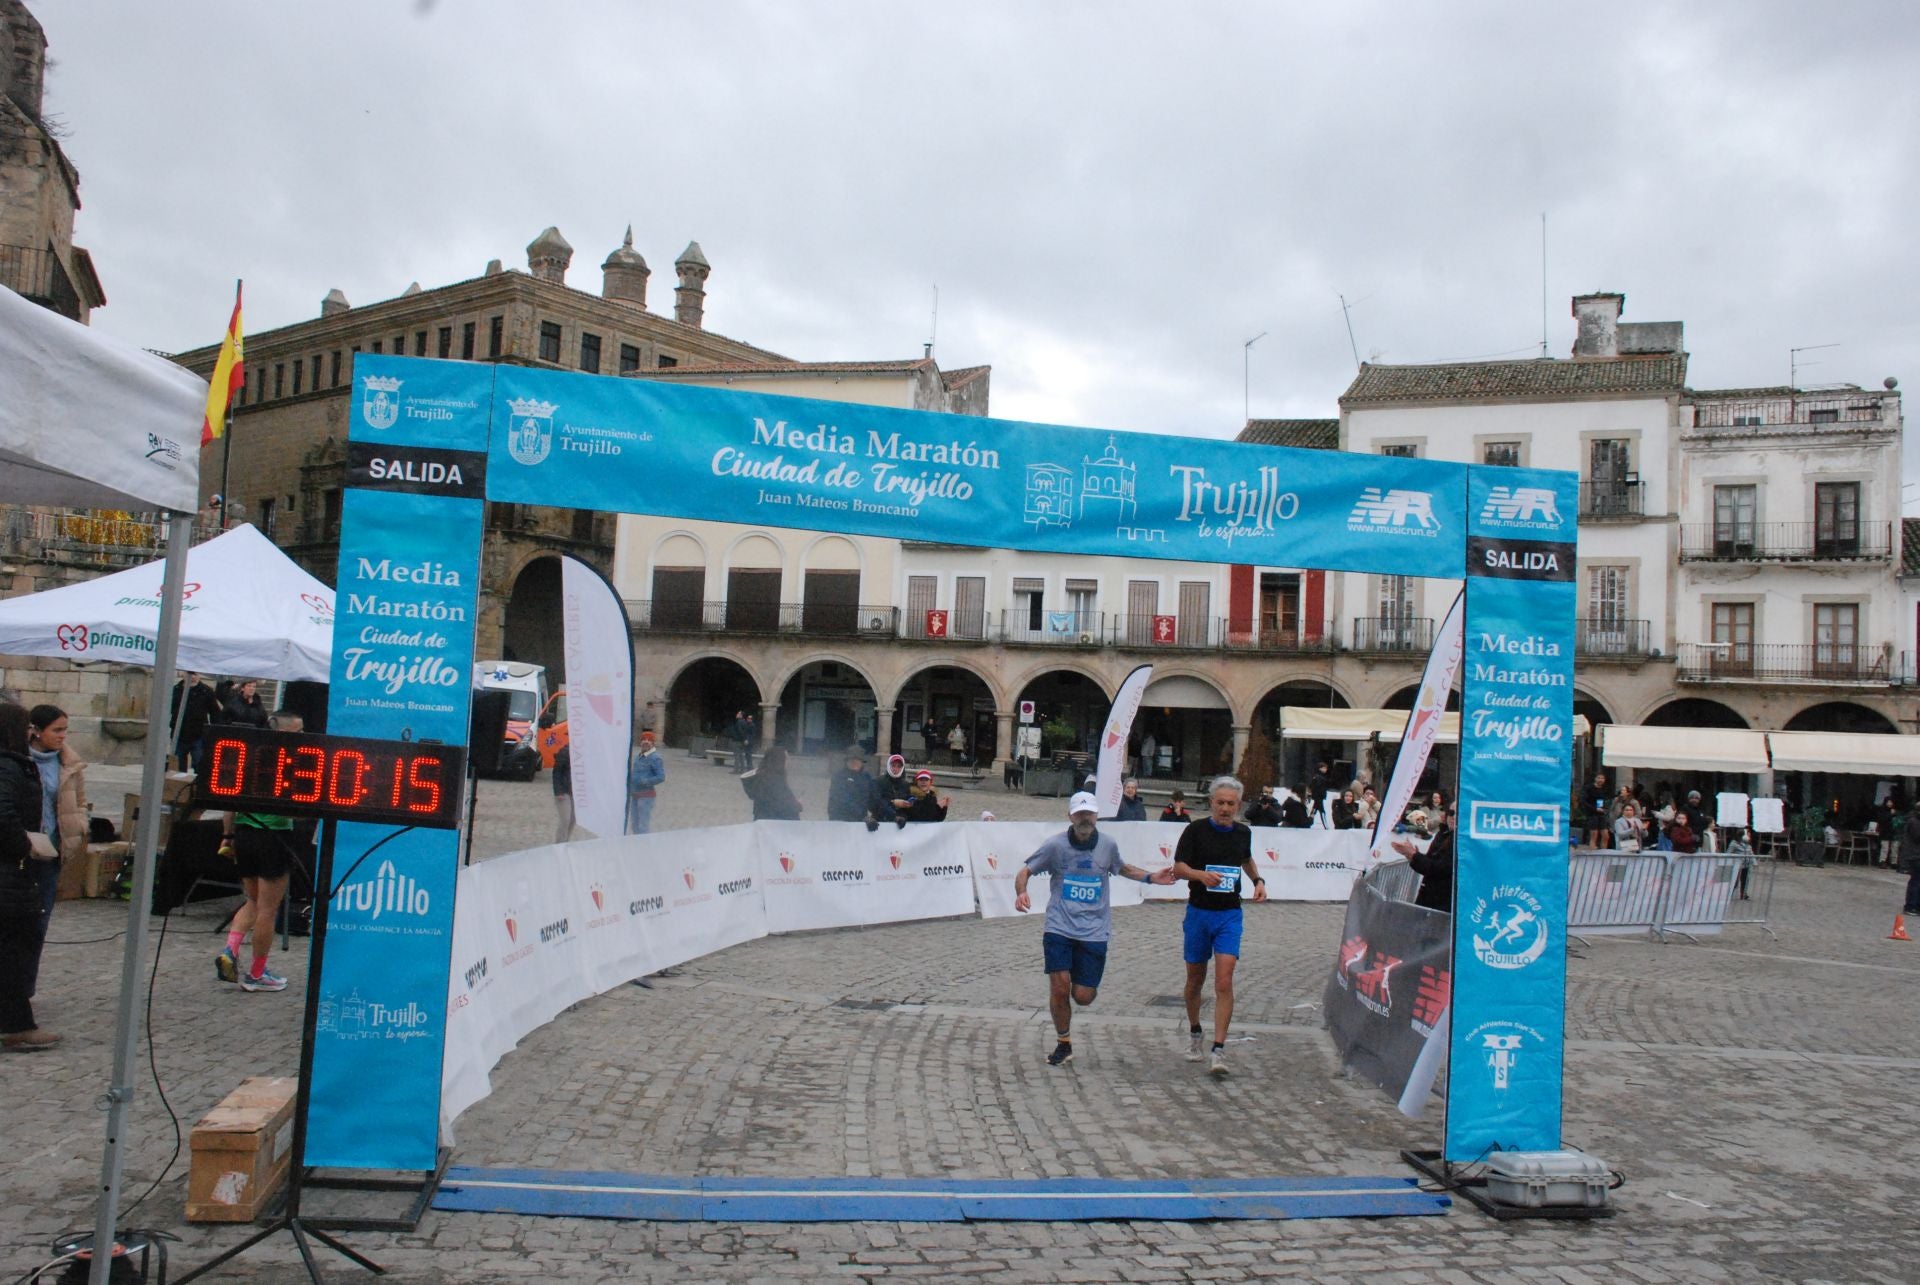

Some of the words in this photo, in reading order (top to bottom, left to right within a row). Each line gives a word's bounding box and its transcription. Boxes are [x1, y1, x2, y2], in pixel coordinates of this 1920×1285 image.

[406, 395, 467, 409] Ayuntamiento
[468, 400, 479, 410] de
[405, 407, 454, 422] Trujillo
[562, 423, 637, 441] Ayuntamiento
[639, 431, 654, 442] de
[752, 417, 855, 455] Media
[865, 430, 1000, 469] Maratón
[560, 437, 621, 457] Trujillo
[369, 457, 463, 485] SALIDA
[712, 447, 820, 484] Ciudad
[824, 461, 863, 488] de
[871, 462, 973, 505] Trujillo
[757, 489, 791, 505] Juan
[796, 493, 848, 511] Mateos
[853, 500, 919, 518] Broncano
[1170, 464, 1300, 531] Trujillo
[1199, 517, 1213, 537] te
[1347, 523, 1437, 537] www.musicrun.es
[1480, 518, 1559, 530] www.musicrun.es
[1485, 549, 1559, 572] SALIDA
[356, 557, 460, 587] Media
[114, 597, 199, 611] primor
[347, 593, 466, 622] Maratón
[360, 626, 423, 647] Ciudad
[424, 632, 448, 648] de
[1480, 632, 1560, 657] Media
[344, 648, 458, 695] Trujillo
[1473, 663, 1566, 687] Maratón
[345, 697, 368, 707] Juan
[370, 698, 405, 709] Mateos
[408, 701, 454, 712] Broncano
[1484, 691, 1531, 709] Ciudad
[1532, 695, 1551, 710] de
[1471, 708, 1562, 749] Trujillo
[1474, 751, 1492, 761] Juan
[209, 739, 440, 812] 01:30:15
[1482, 813, 1547, 832] HABLA
[1070, 885, 1095, 900] 509
[1470, 896, 1487, 925] Club
[1492, 883, 1543, 912] Atletismo
[1478, 948, 1531, 966] TRUJILLO
[369, 1002, 428, 1028] Trujillo
[1488, 1053, 1496, 1067] A
[1508, 1053, 1516, 1068] J
[1498, 1067, 1505, 1081] S
